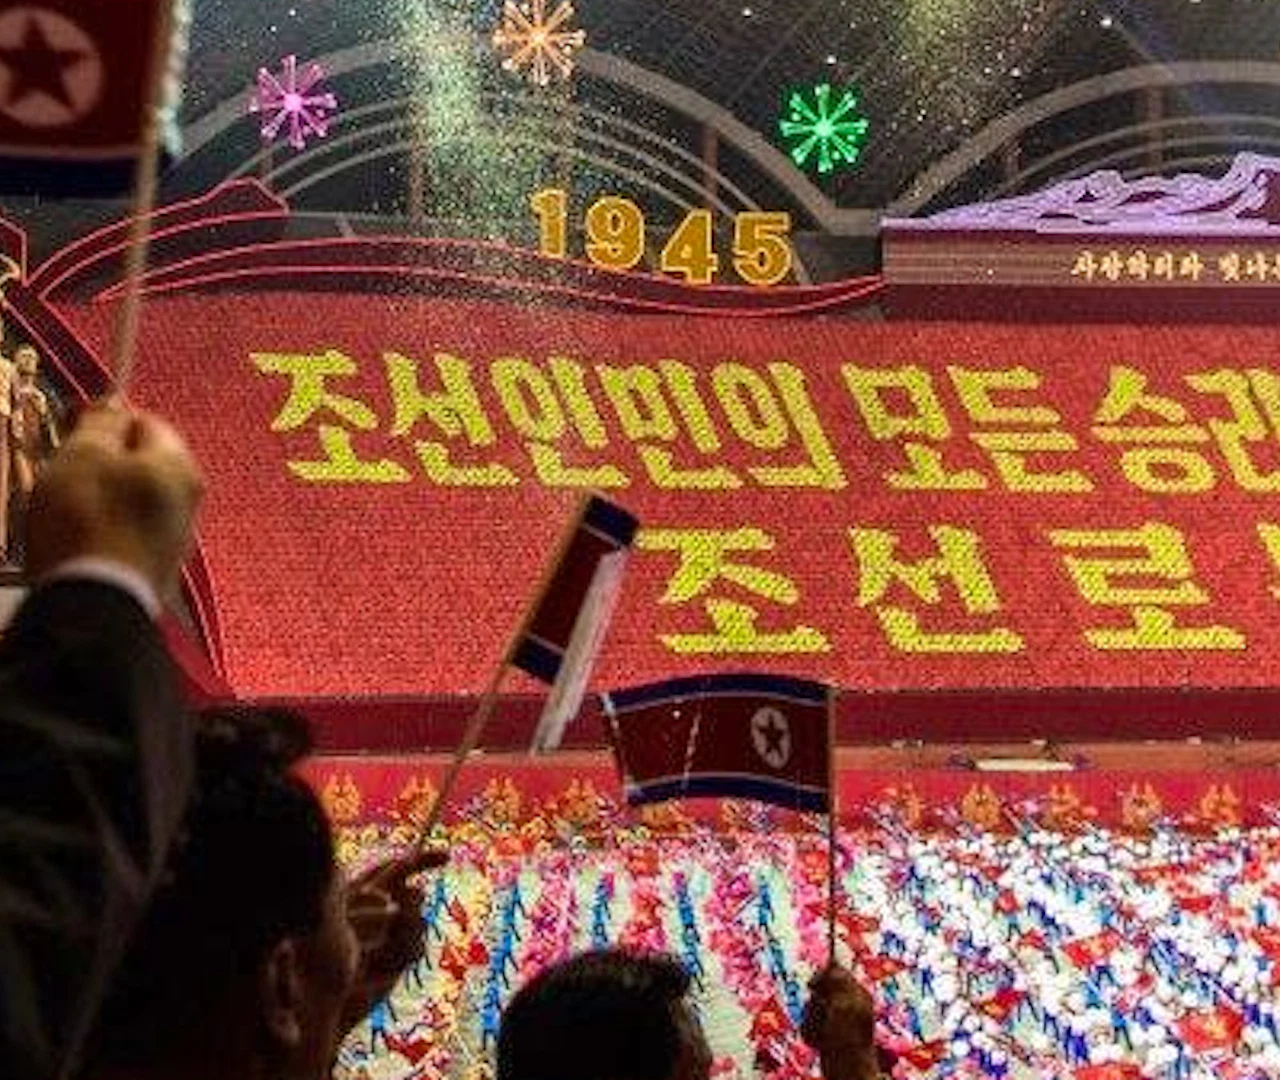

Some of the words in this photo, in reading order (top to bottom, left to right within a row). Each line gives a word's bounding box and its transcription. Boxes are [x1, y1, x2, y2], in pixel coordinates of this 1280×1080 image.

[529, 186, 793, 287] 1945
[250, 350, 847, 493] 조선인민의
[841, 362, 1095, 493] 모든
